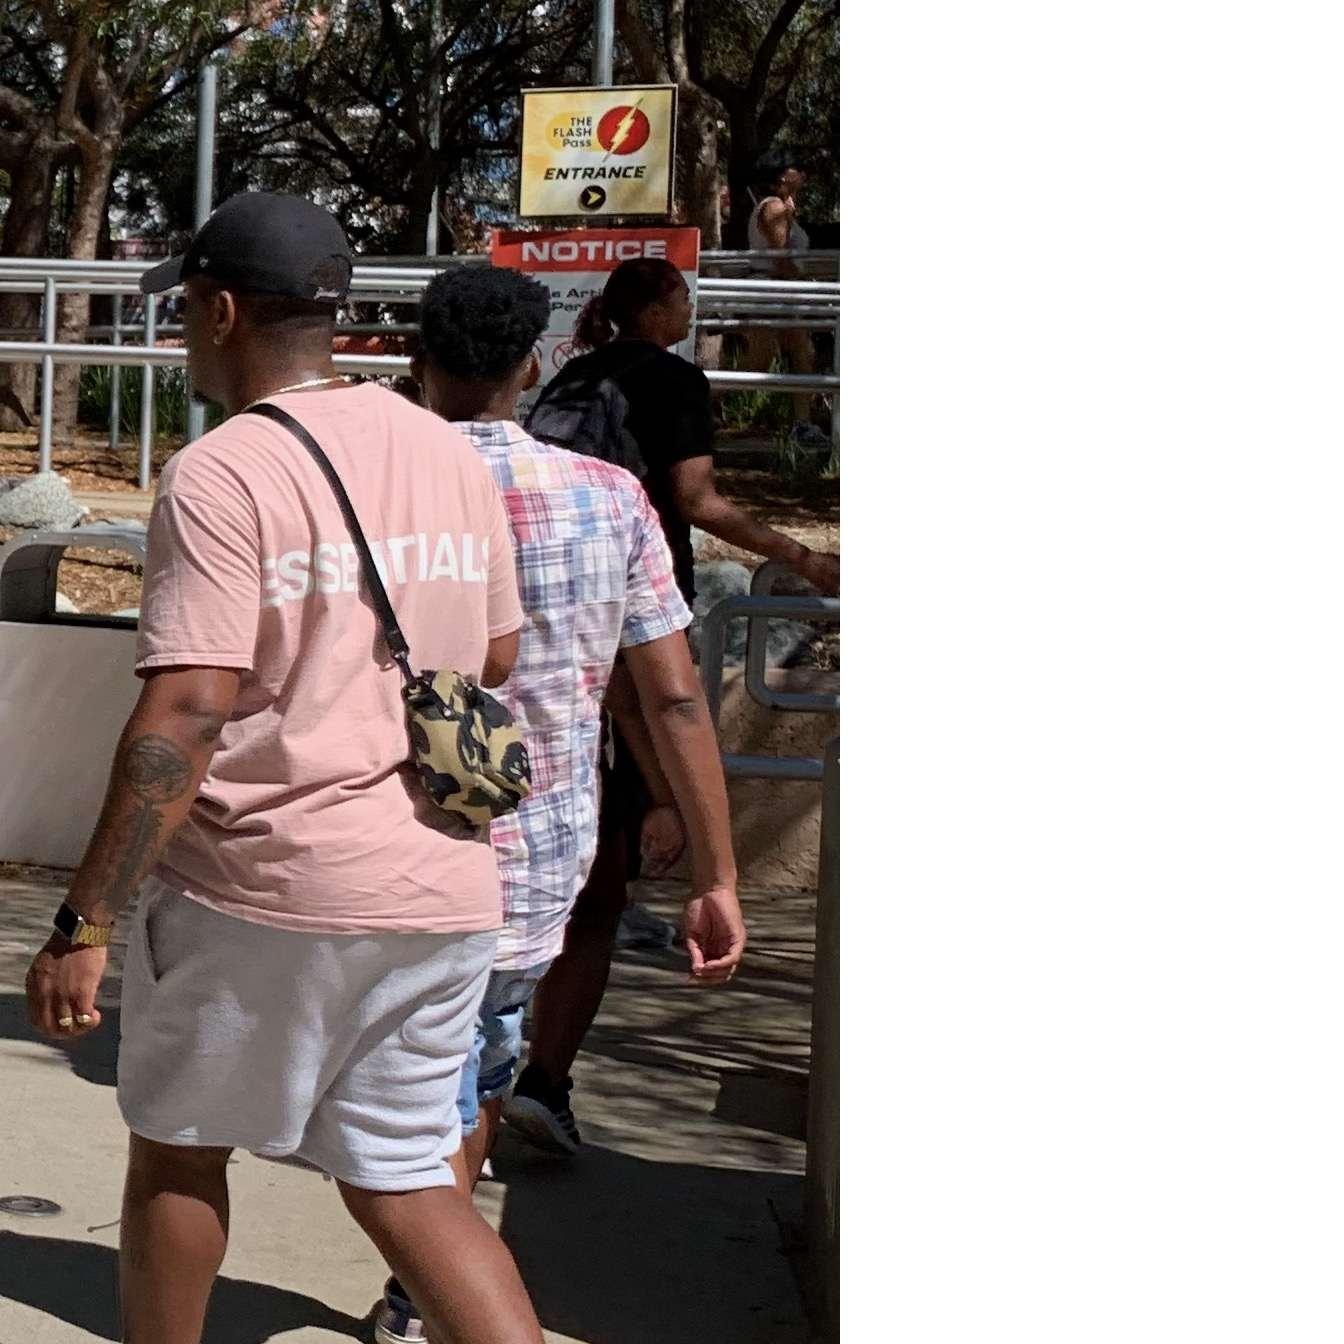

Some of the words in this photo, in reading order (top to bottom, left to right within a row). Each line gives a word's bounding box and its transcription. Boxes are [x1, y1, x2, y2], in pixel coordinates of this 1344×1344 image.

[570, 116, 592, 126] THE
[553, 128, 592, 138] FLASH
[562, 138, 592, 148] Pass
[543, 165, 647, 180] ENTRANCE
[521, 240, 667, 262] NOTICE
